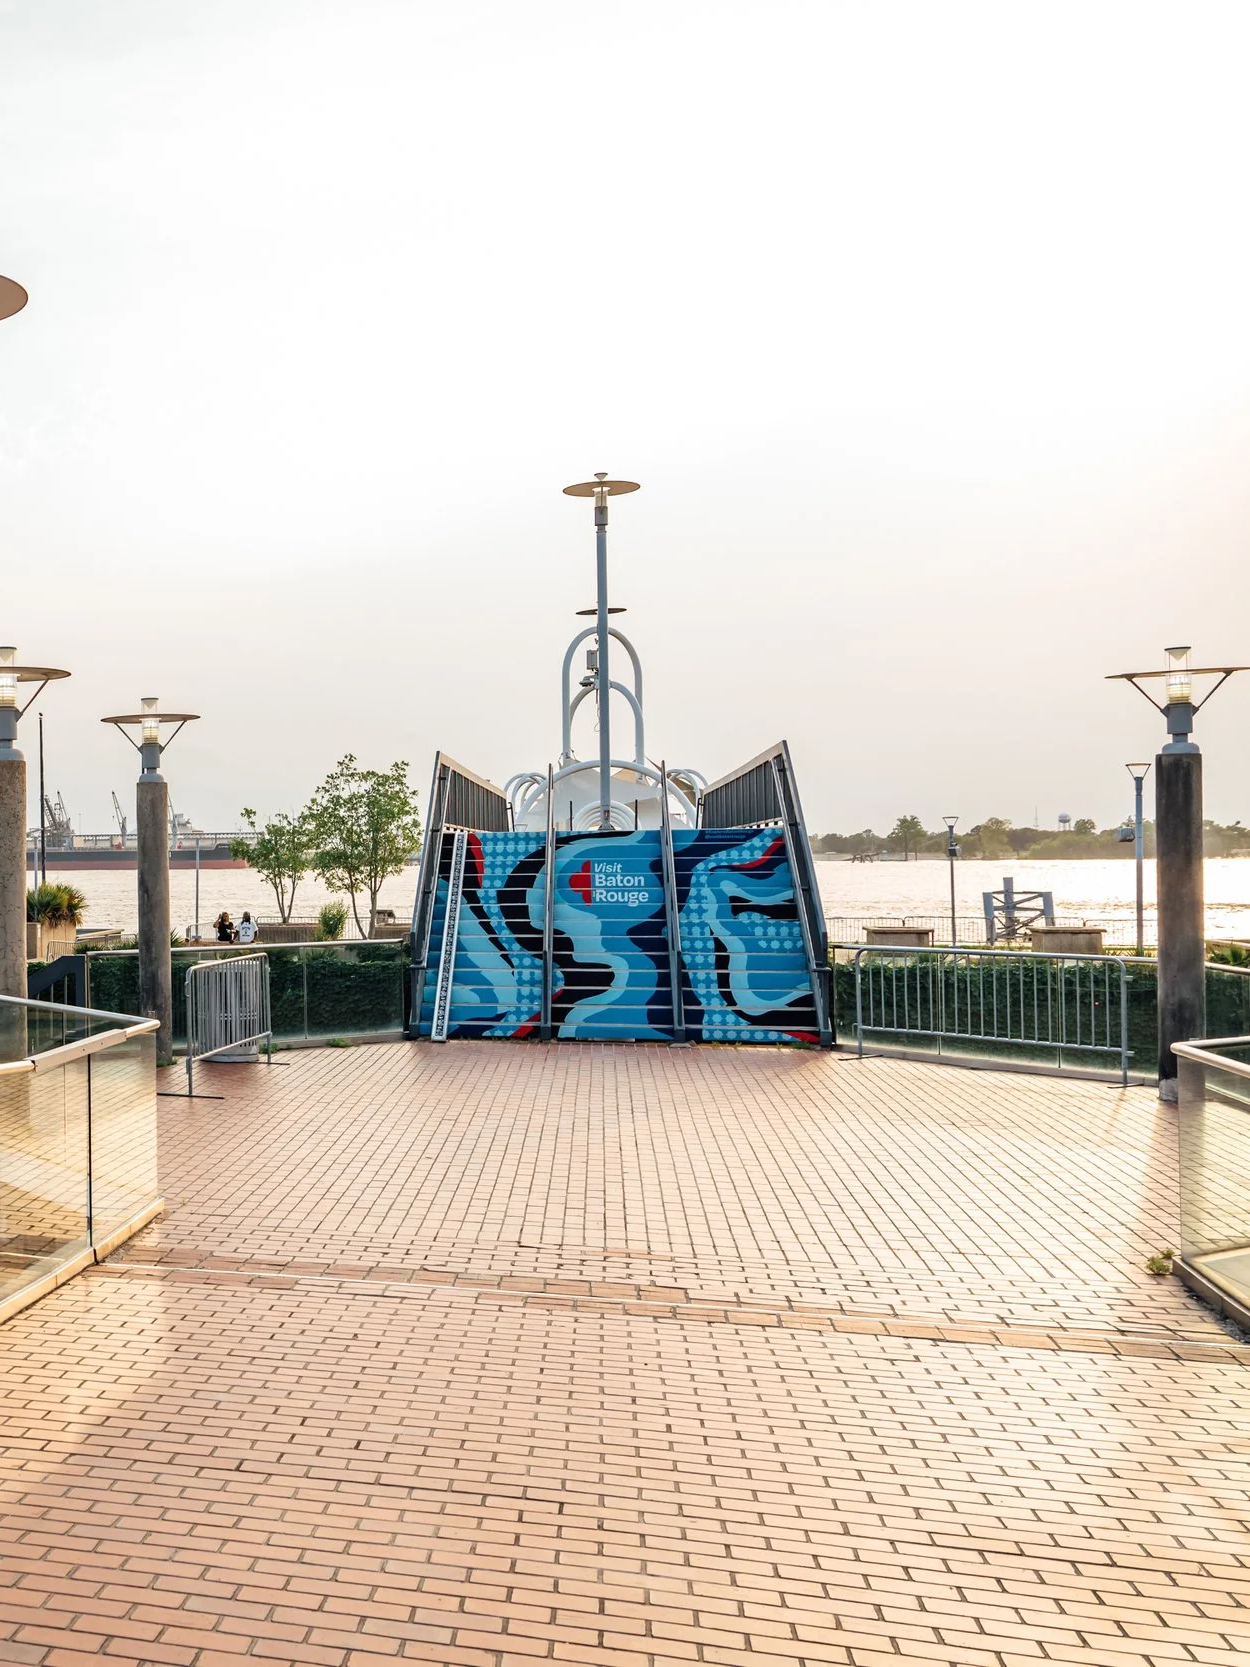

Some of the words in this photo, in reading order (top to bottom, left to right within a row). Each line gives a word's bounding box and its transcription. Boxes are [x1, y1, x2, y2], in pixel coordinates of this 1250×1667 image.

[594, 862, 622, 873] Visit
[595, 873, 645, 887] Baton
[595, 889, 649, 907] Rouge
